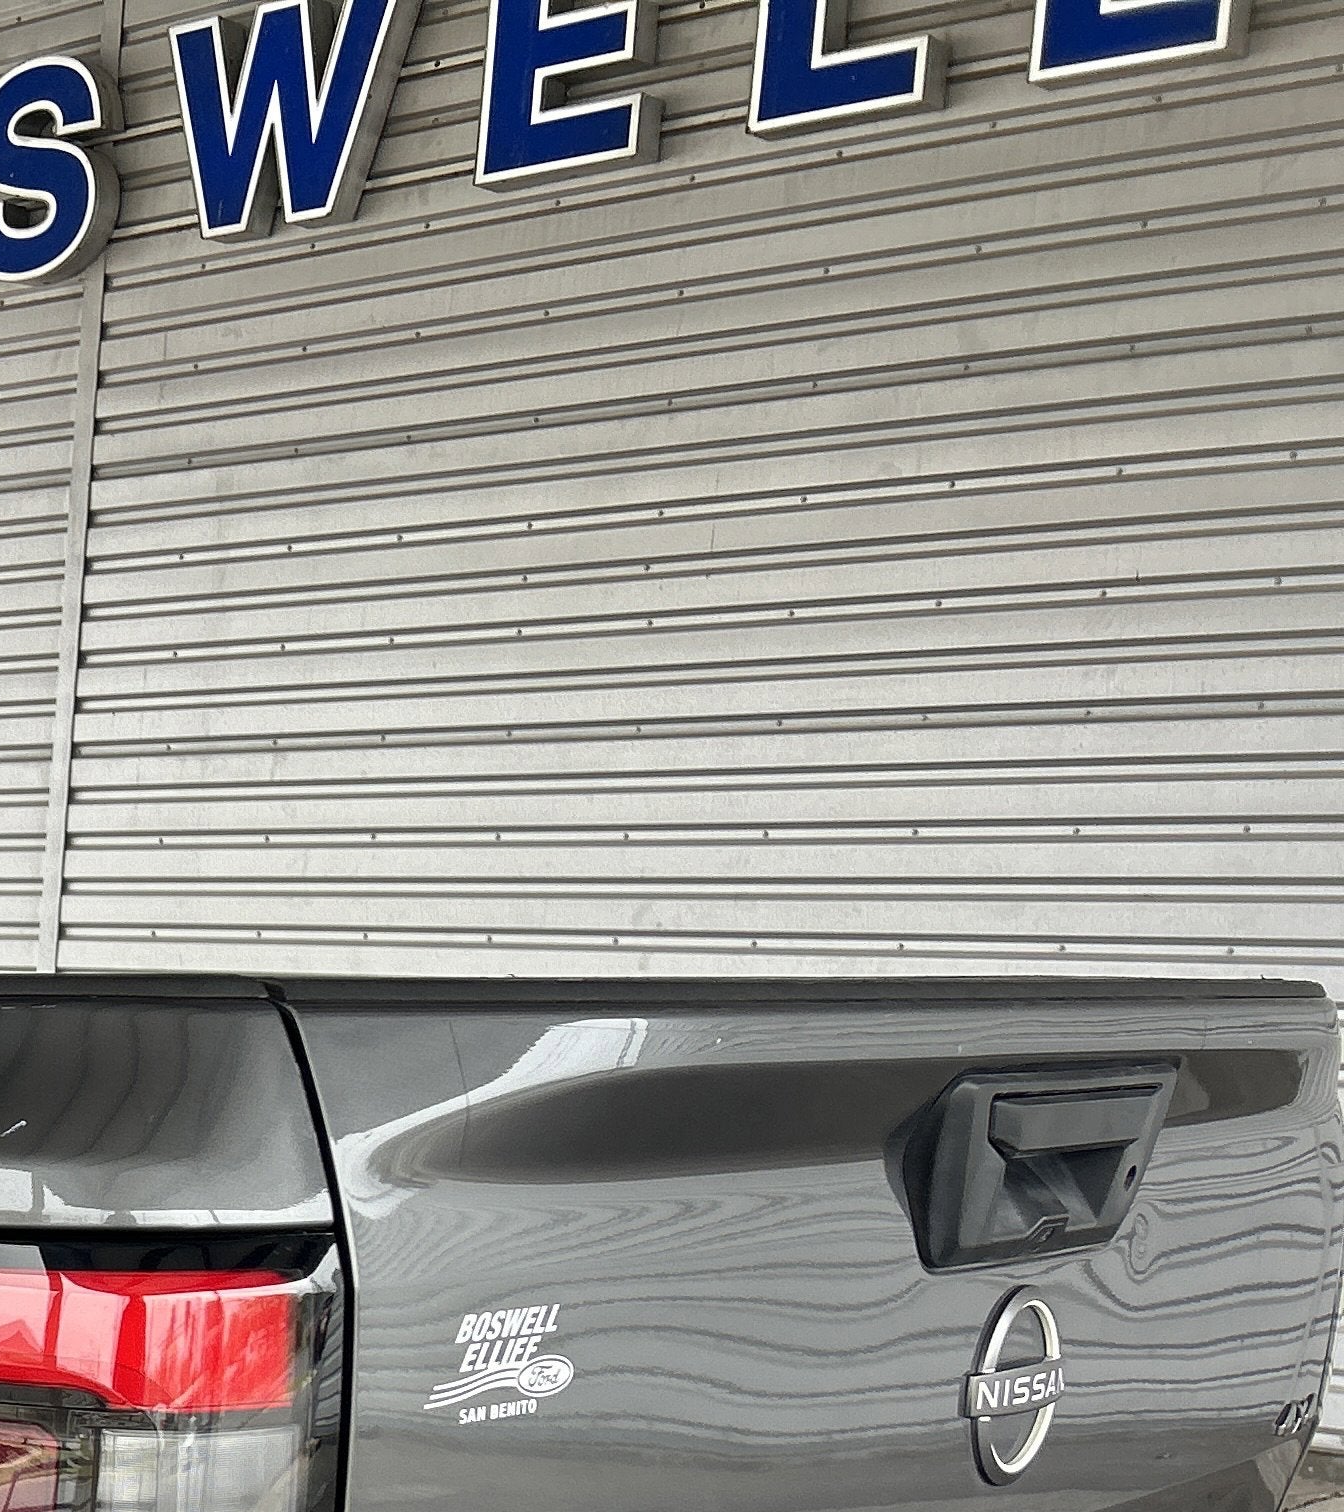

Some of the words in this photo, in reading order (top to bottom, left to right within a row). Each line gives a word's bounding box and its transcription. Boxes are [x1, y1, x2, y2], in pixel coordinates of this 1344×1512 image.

[455, 1304, 560, 1344] BOSWELL
[459, 1335, 541, 1373] ELLIFF
[528, 1364, 562, 1387] Ford
[975, 1367, 1065, 1410] NISSAN
[458, 1405, 487, 1425] SAN
[490, 1398, 538, 1420] BENITO
